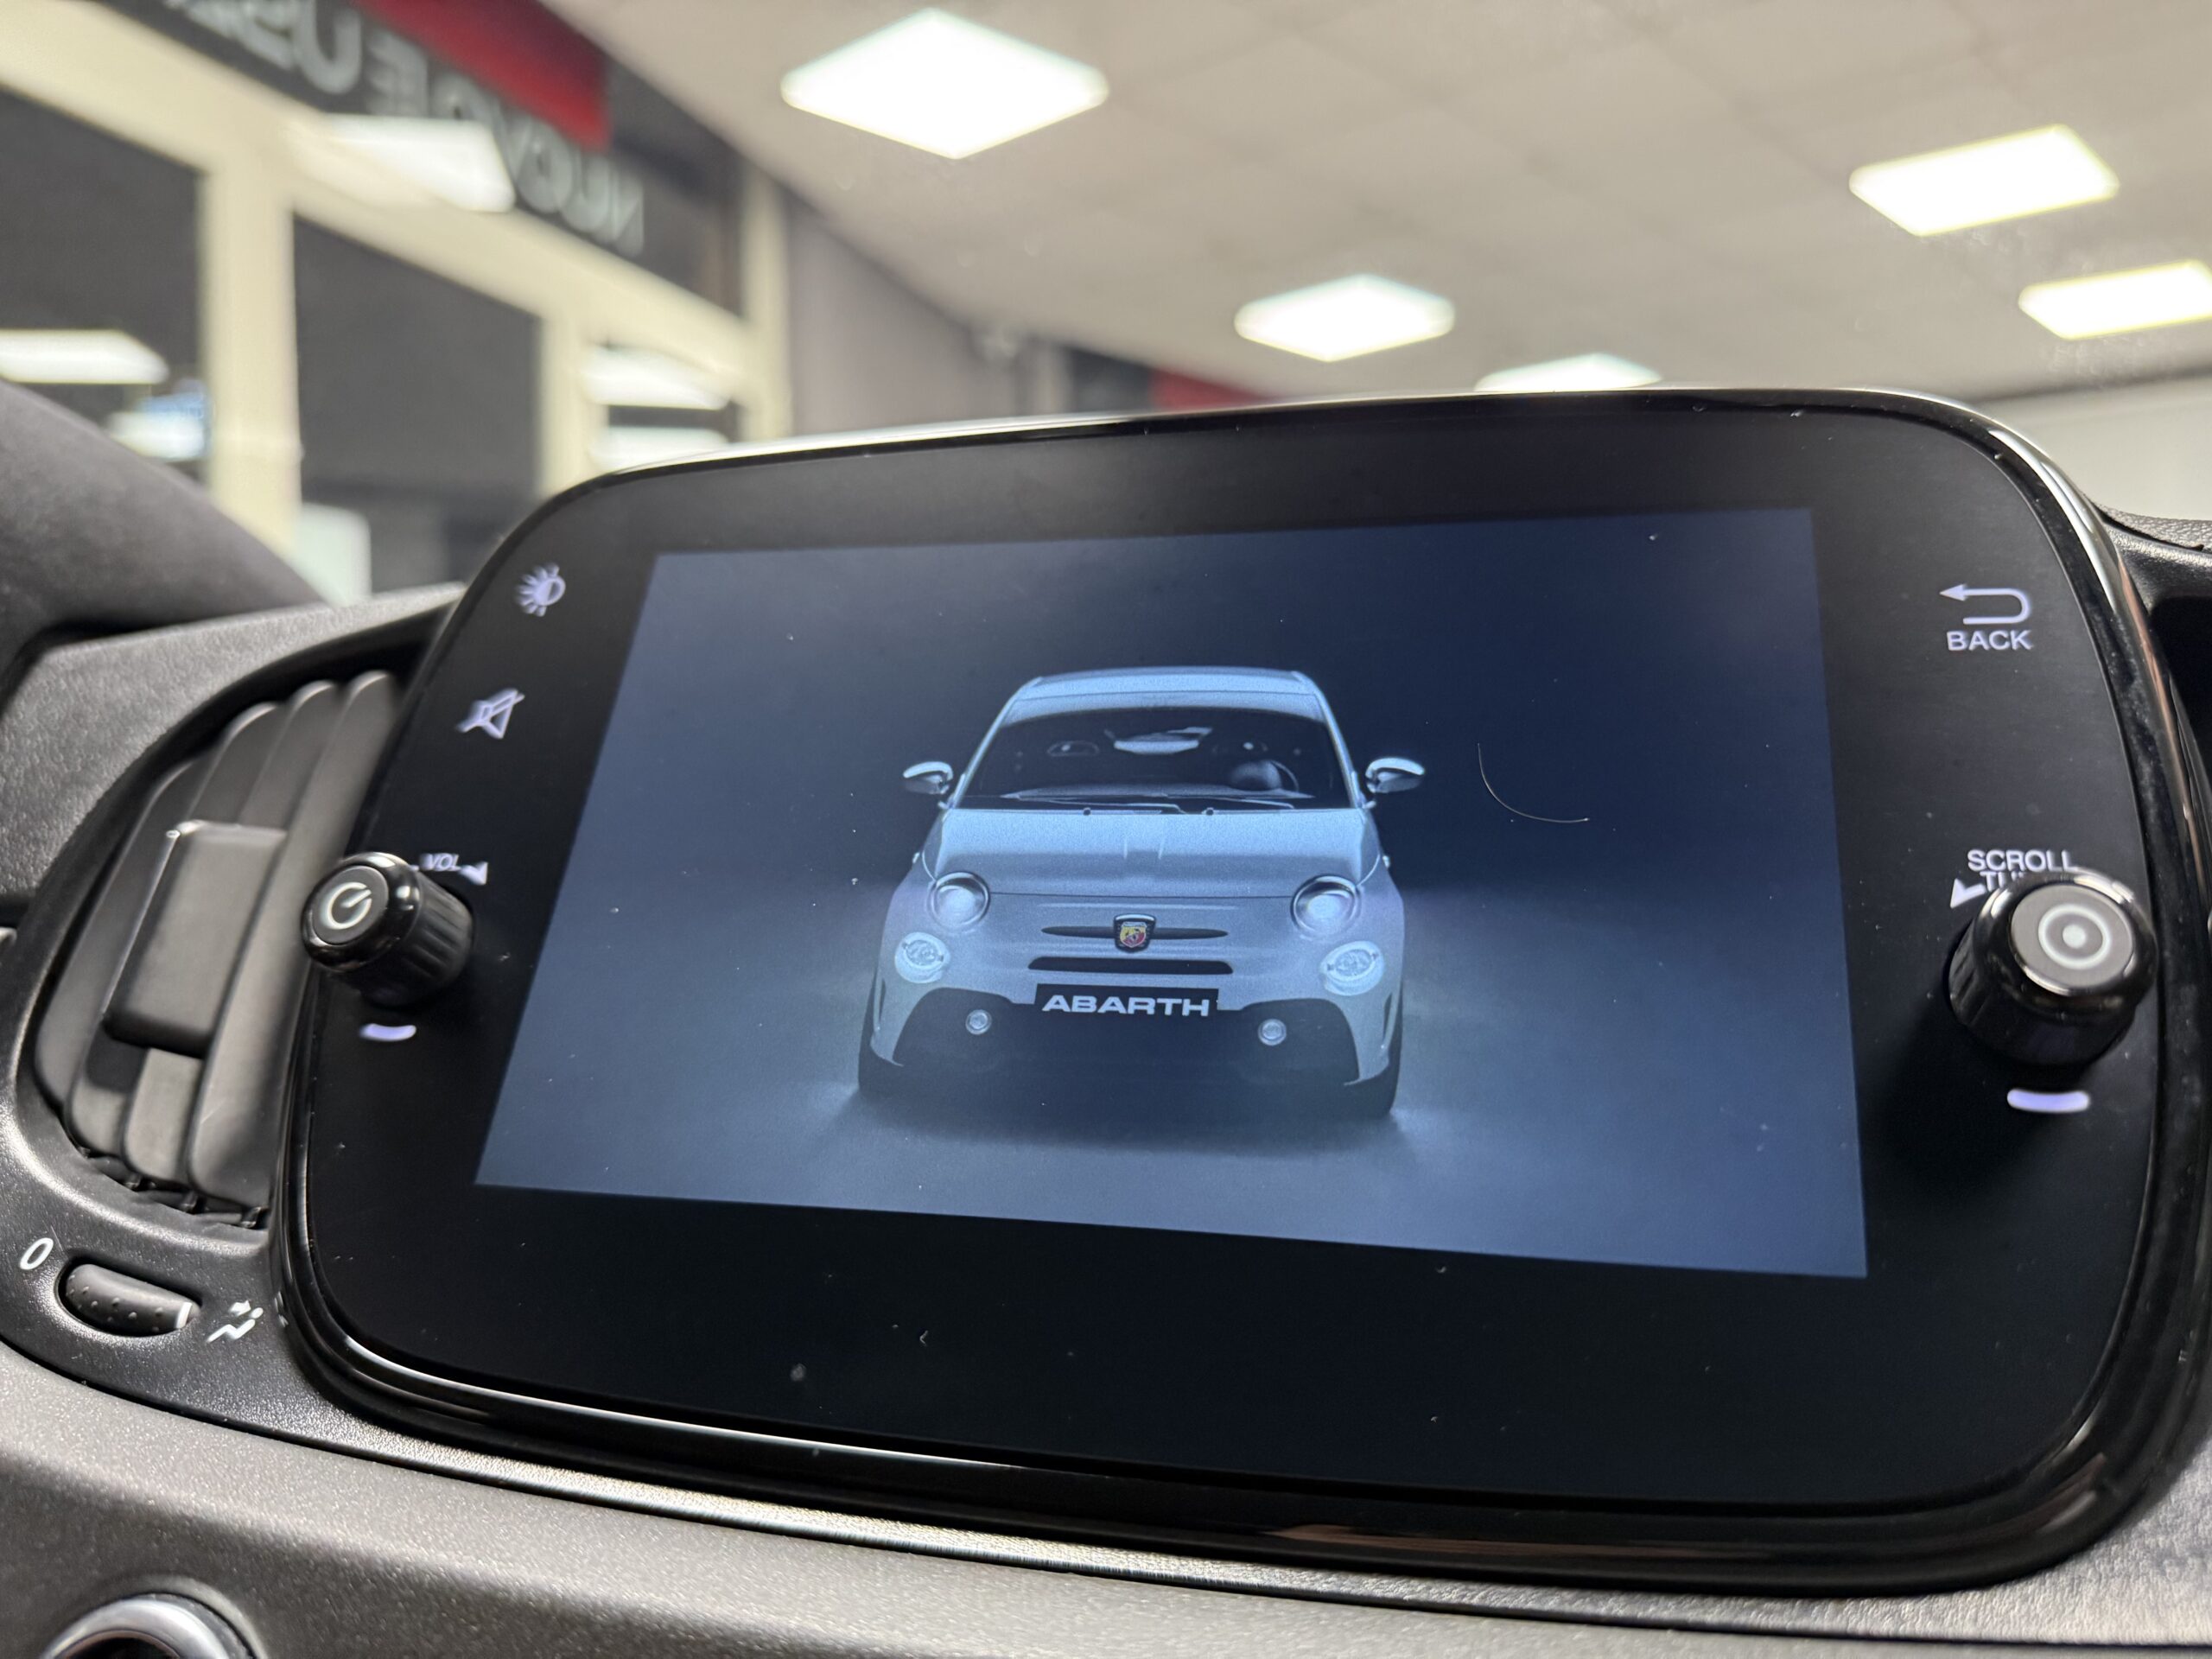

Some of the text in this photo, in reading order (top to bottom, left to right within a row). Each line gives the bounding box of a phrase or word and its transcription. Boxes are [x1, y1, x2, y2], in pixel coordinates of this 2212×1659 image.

[1946, 629, 2034, 652] BACK
[420, 852, 461, 872] VOL
[1967, 849, 2079, 872] SCROLL
[1041, 995, 1210, 1017] ABARTH
